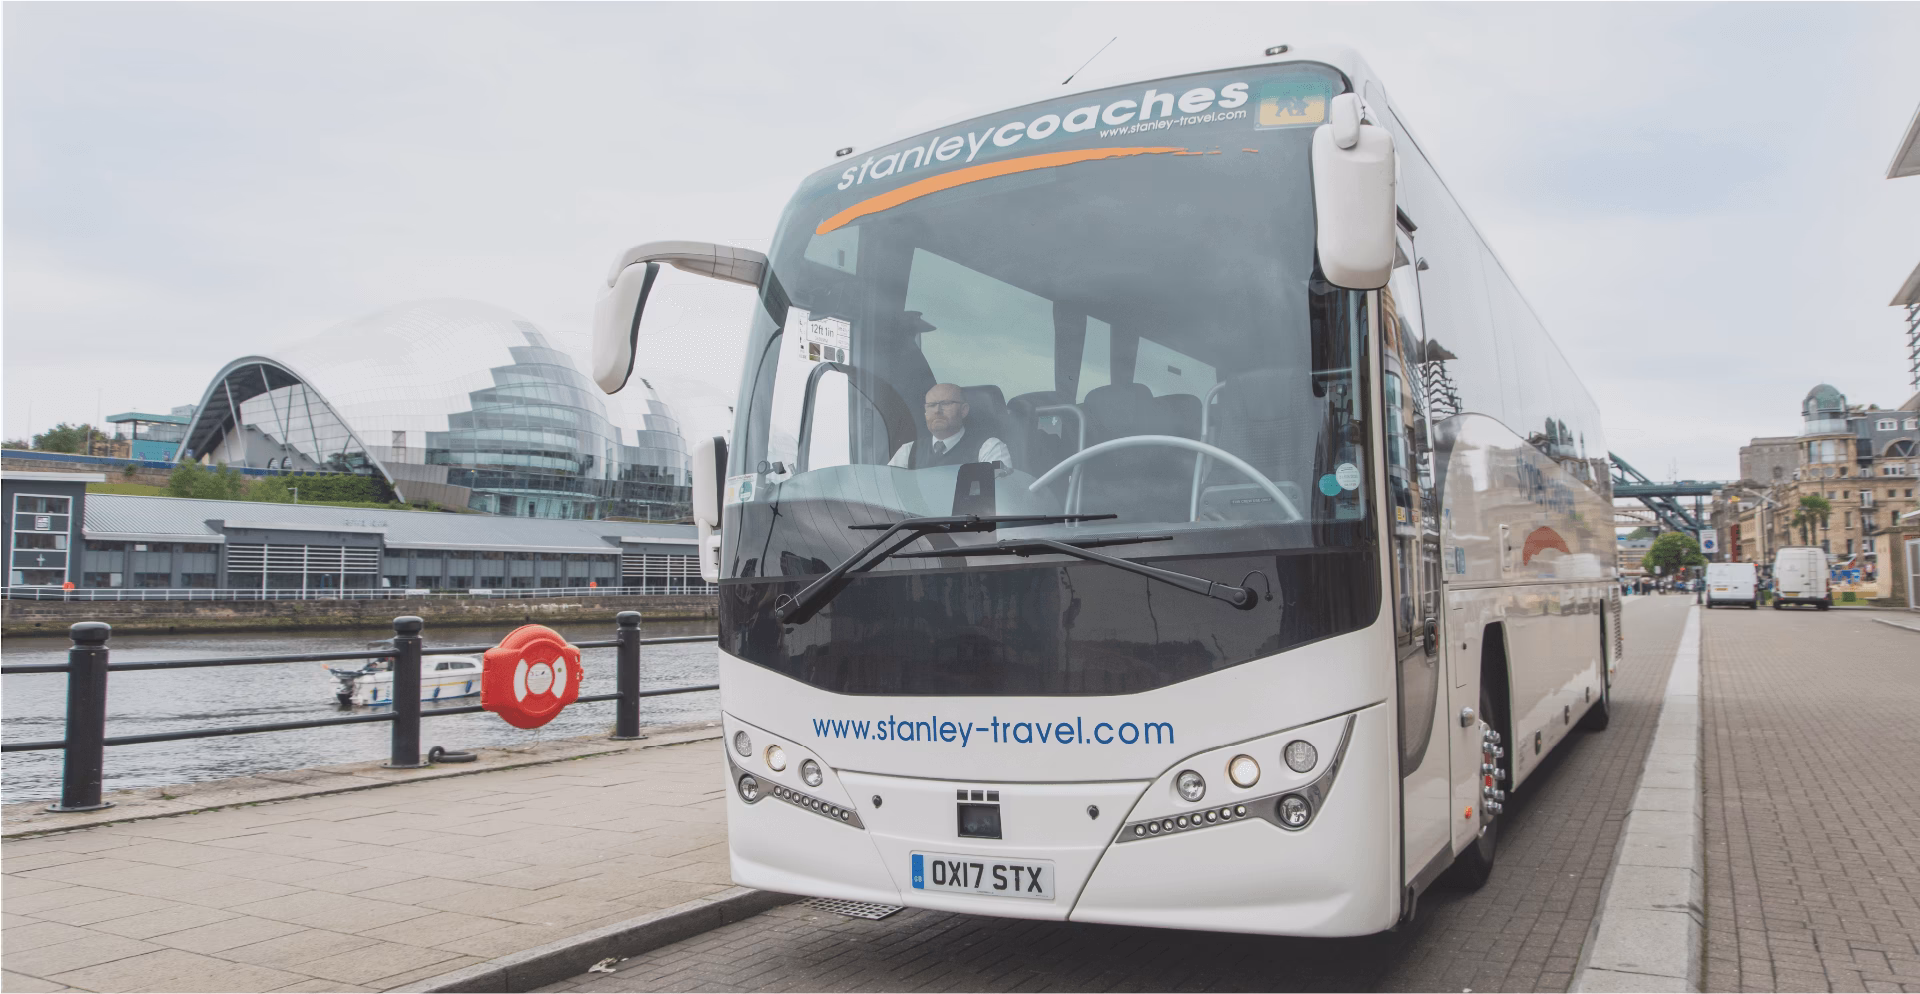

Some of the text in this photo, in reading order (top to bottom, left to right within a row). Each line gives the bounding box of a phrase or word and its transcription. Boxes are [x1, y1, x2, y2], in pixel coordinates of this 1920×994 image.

[1100, 109, 1247, 138] www.stanley-travel.com
[811, 323, 823, 335] 12ft
[812, 715, 1175, 747] www.stanley-travel.com
[932, 860, 1043, 893] OX17 STX
